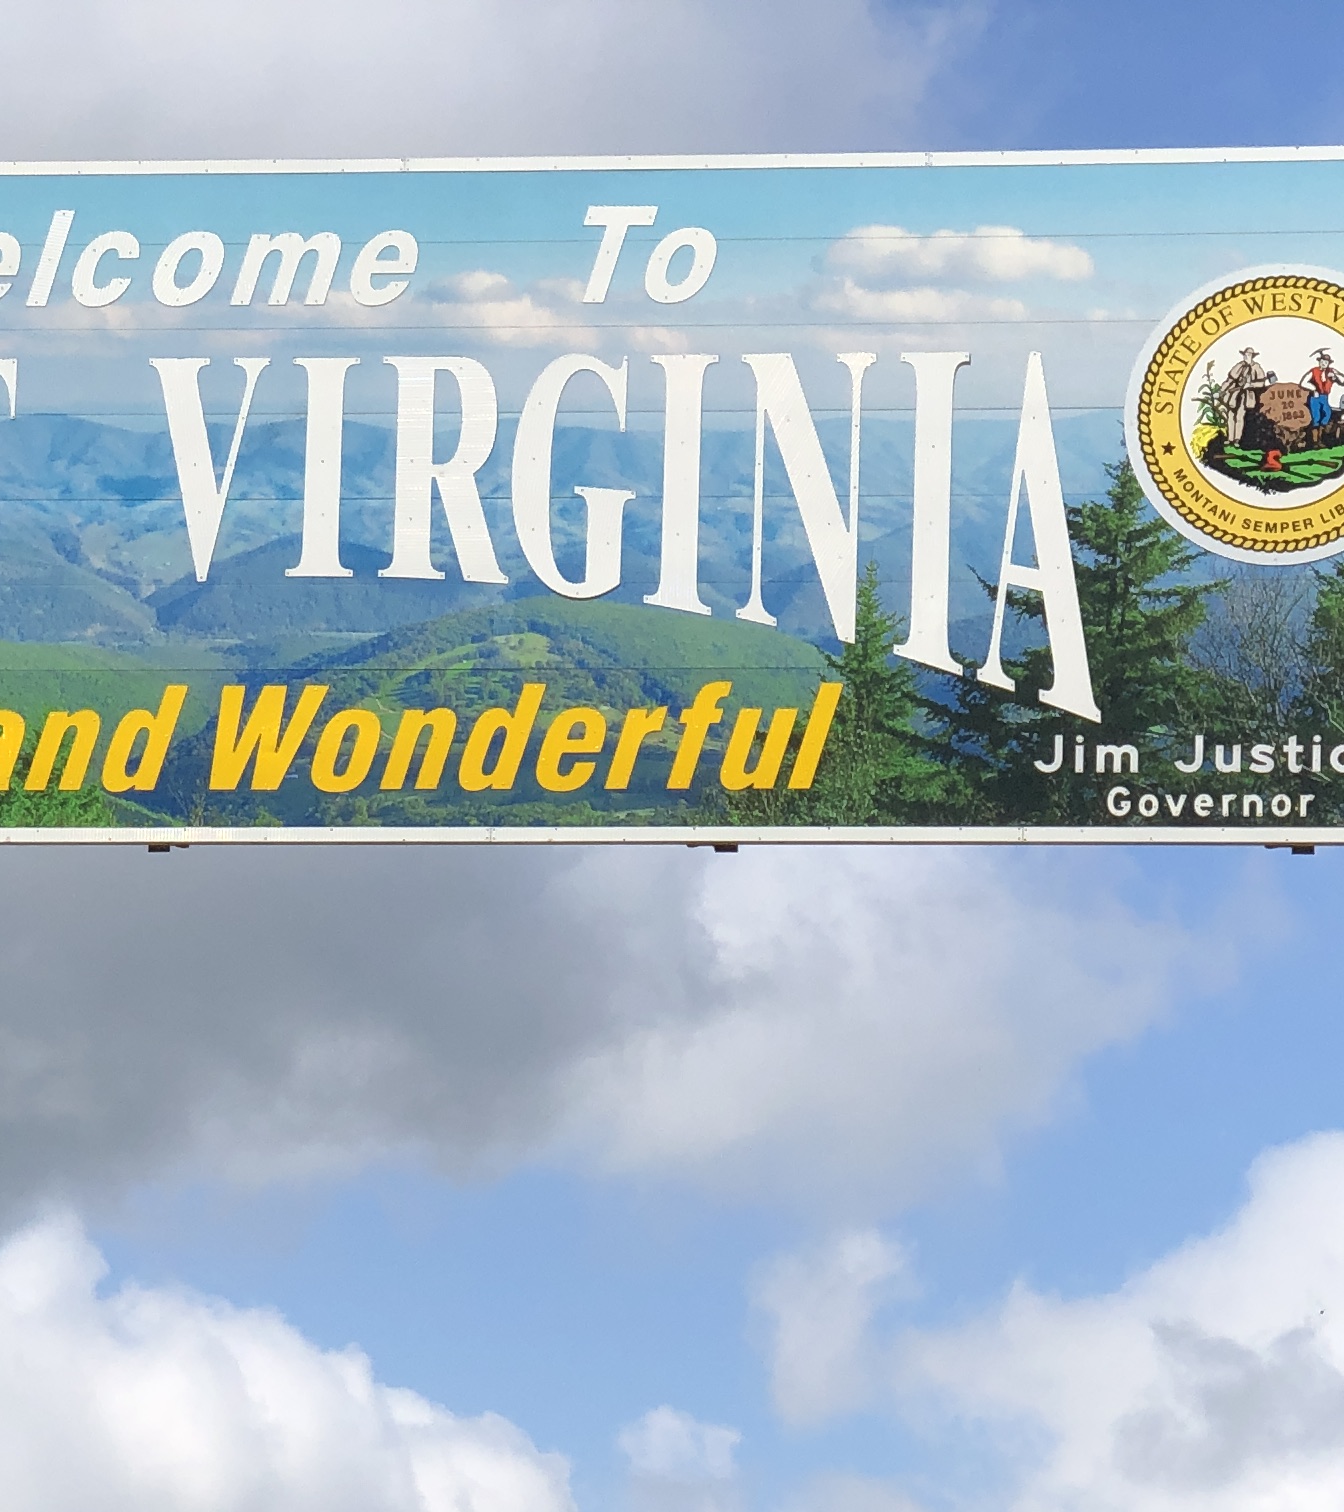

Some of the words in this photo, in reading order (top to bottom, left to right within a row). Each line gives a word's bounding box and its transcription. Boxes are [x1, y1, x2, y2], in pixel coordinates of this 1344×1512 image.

[582, 205, 717, 304] To
[1155, 338, 1202, 415] STATE
[1201, 305, 1235, 336] OF
[1241, 292, 1323, 315] WEST
[1269, 389, 1302, 401] JUNE
[1281, 400, 1295, 410] 20
[1173, 467, 1237, 526] MONTANI
[1241, 517, 1315, 534] SEMPER
[149, 351, 1102, 722] VIRGINIA
[208, 681, 844, 793] Wonderful
[1034, 734, 1140, 774] Jim
[1106, 786, 1316, 818] Governor
